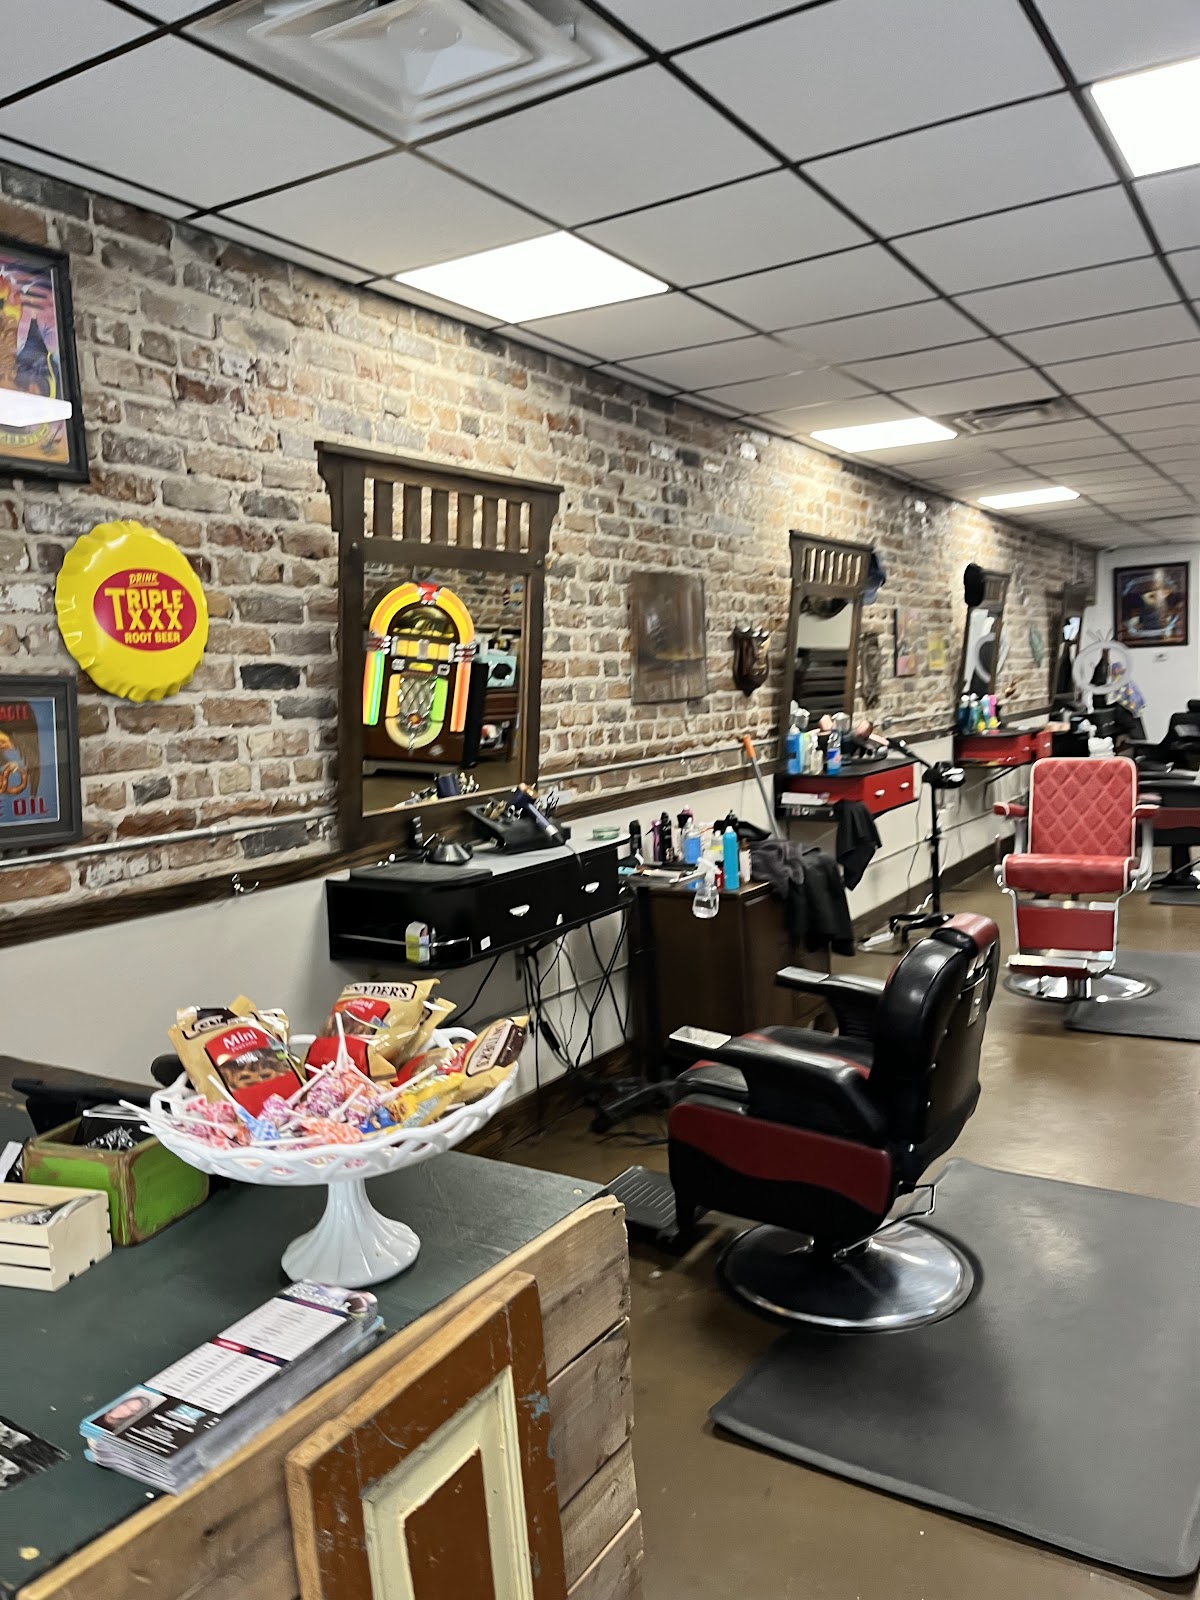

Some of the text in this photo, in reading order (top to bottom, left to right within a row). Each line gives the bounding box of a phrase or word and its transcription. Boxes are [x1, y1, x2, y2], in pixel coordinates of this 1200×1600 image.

[128, 572, 159, 588] DRINK
[104, 588, 184, 630] TRIPLE
[128, 609, 183, 630] XXX
[124, 632, 181, 644] ROOT BEER
[13, 796, 49, 816] OIL
[222, 1029, 259, 1050] Mini
